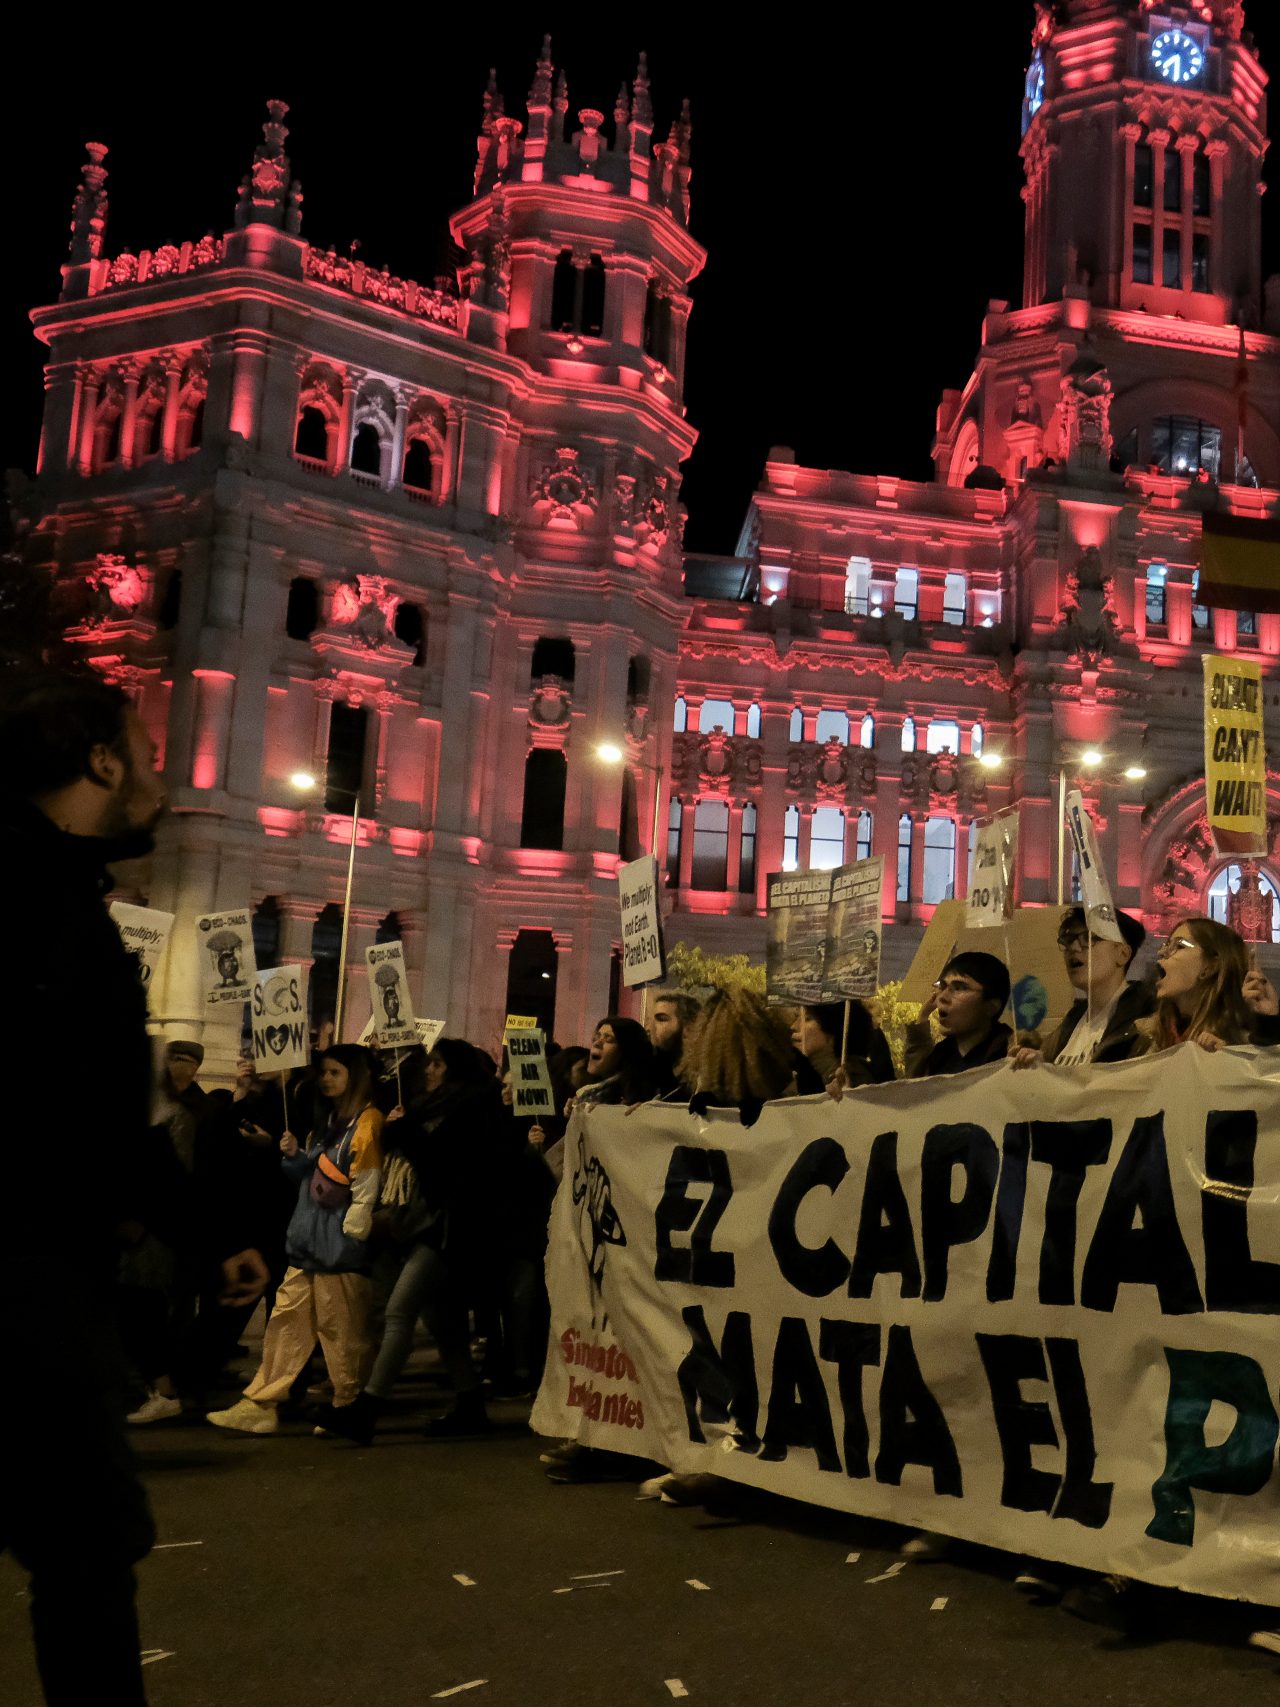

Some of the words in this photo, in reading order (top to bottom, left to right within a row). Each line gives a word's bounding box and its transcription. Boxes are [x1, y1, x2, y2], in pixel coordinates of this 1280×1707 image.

[971, 888, 990, 908] no
[509, 1038, 541, 1056] CLEAN
[521, 1063, 540, 1081] AIR
[517, 1088, 549, 1107] NOW!
[654, 1146, 735, 1288] EL
[677, 1305, 964, 1498] MATA
[975, 1333, 1115, 1529] EL
